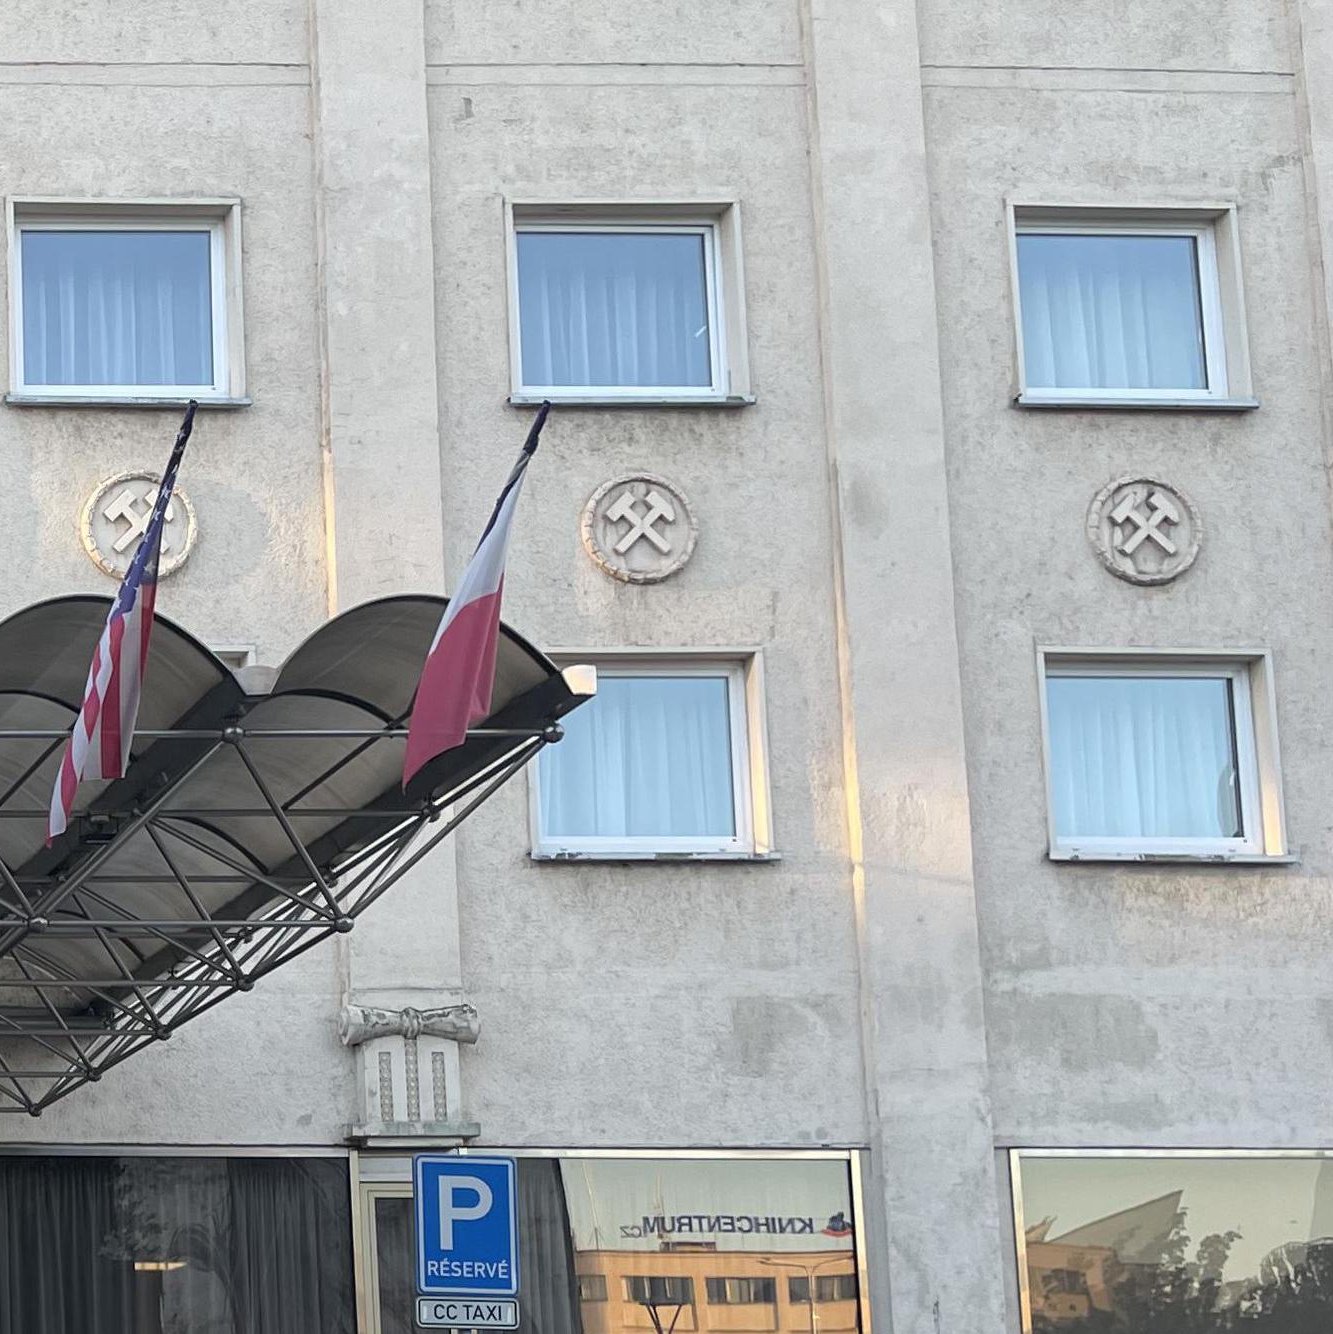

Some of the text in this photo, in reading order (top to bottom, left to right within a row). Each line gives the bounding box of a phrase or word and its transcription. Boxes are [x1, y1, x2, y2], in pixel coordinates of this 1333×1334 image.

[438, 1175, 493, 1251] P
[427, 1257, 510, 1279] RÉSERVÉ
[433, 1304, 502, 1322] CC TAXI
